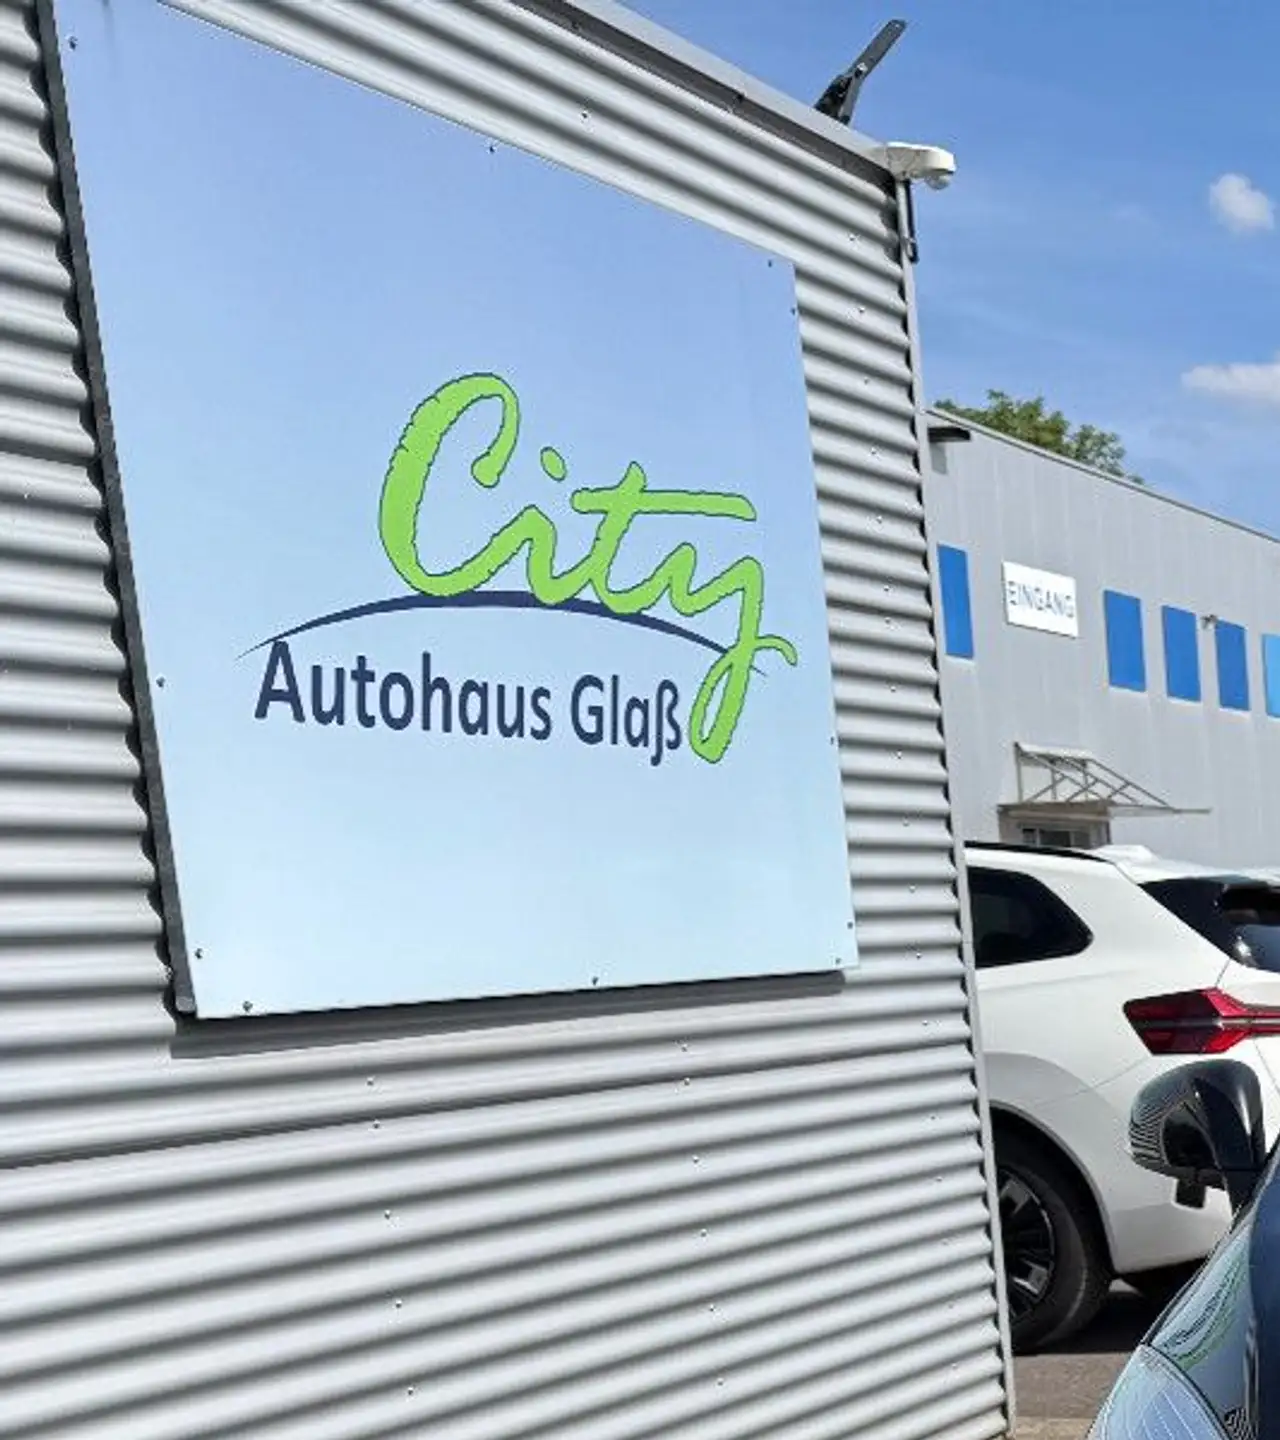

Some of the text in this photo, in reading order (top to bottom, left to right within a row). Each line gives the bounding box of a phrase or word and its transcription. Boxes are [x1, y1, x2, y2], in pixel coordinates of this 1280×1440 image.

[379, 372, 798, 763] City
[1007, 580, 1075, 618] EINGANG
[254, 640, 682, 766] Autohaus Glaß
